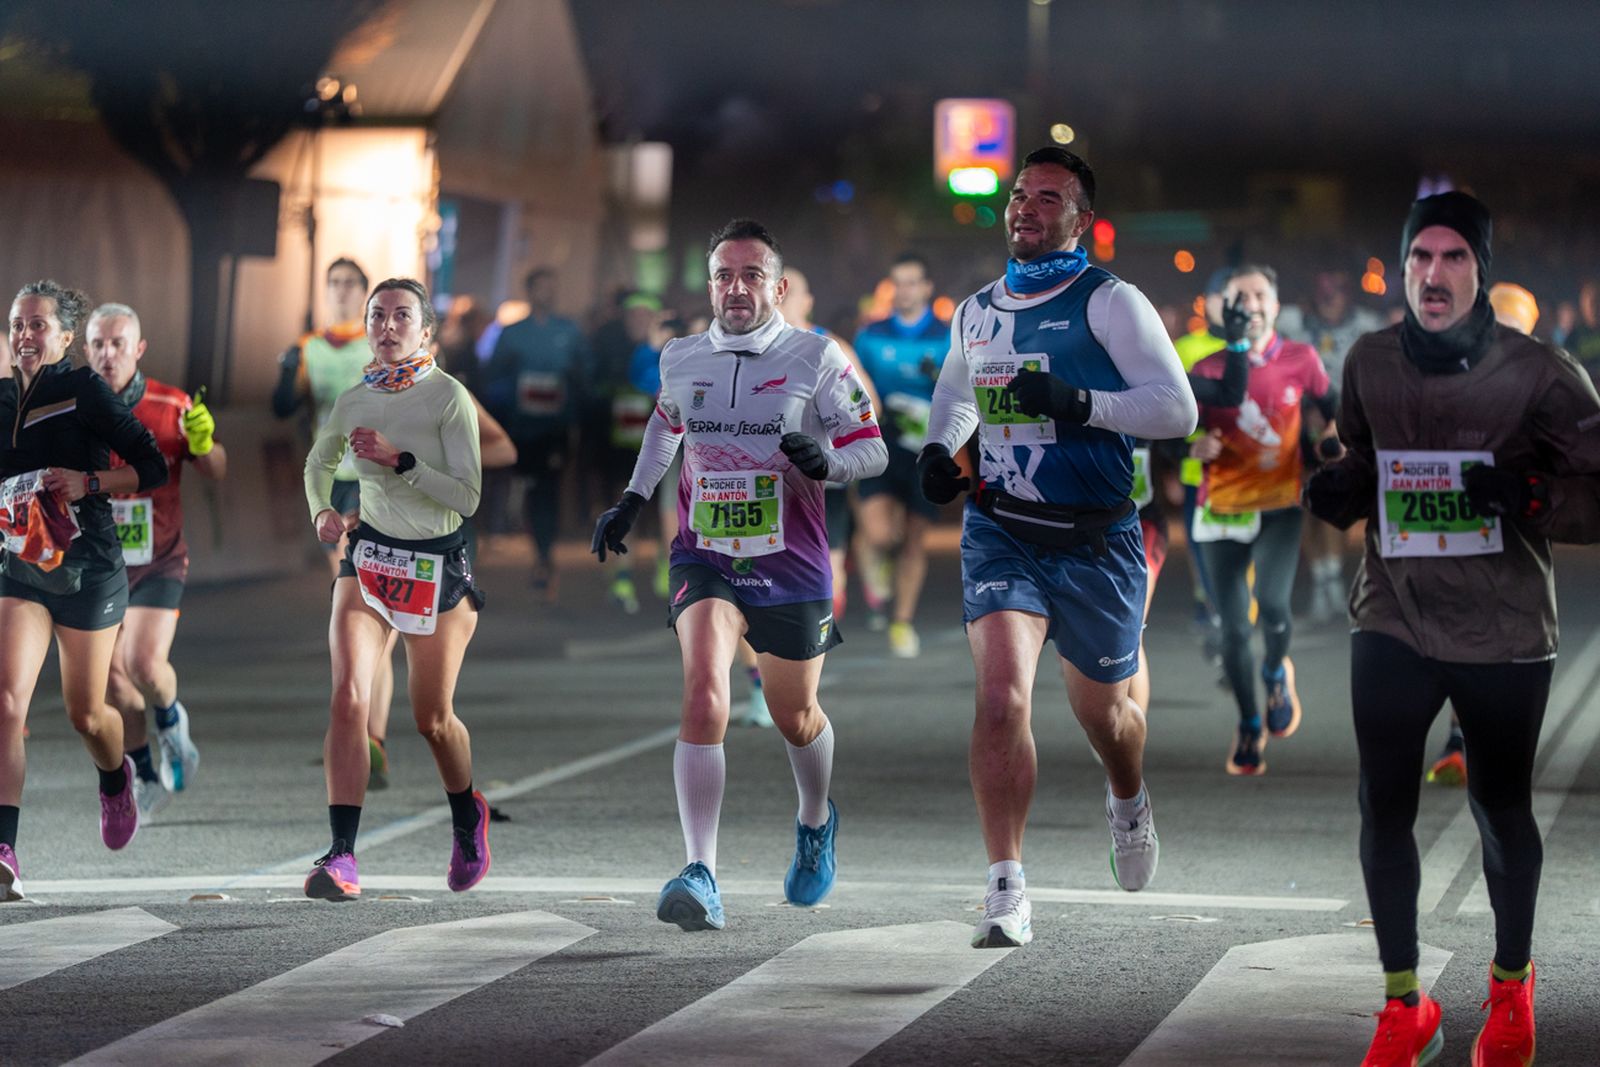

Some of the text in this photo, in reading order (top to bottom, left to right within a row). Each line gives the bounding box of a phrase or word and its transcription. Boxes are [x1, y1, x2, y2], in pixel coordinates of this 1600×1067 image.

[982, 364, 1015, 375] NOCHE DE
[975, 377, 988, 386] SAN
[687, 418, 782, 437] SIERRA DE SEGURA
[1403, 465, 1450, 476] NOCHE DE
[709, 480, 747, 490] NOCHE DE
[1391, 476, 1452, 490] SAN ANTÓN
[702, 491, 716, 501] SAN
[717, 489, 747, 501] ANTÓN
[1401, 491, 1477, 523] 2656
[710, 502, 763, 529] 7155
[361, 560, 380, 572] SAN
[374, 553, 397, 566] NOCHE
[397, 558, 409, 568] DE
[375, 575, 415, 604] 327
